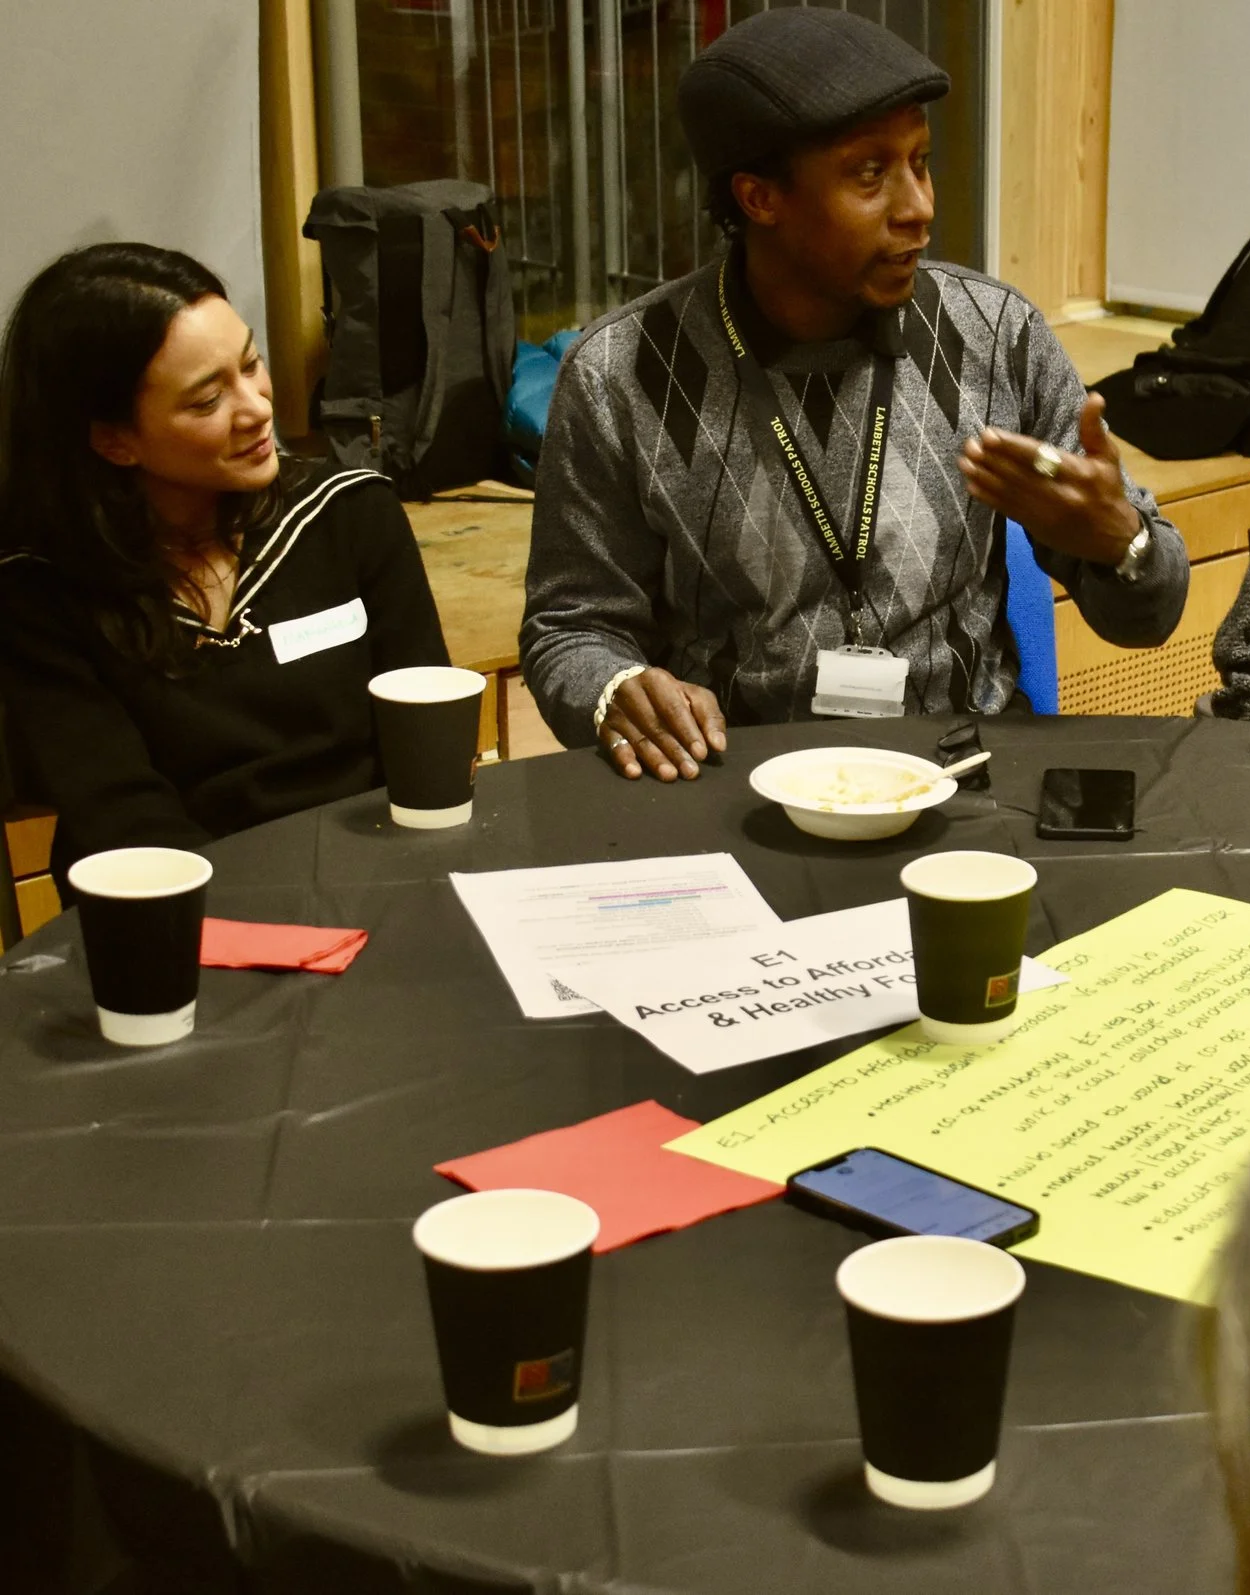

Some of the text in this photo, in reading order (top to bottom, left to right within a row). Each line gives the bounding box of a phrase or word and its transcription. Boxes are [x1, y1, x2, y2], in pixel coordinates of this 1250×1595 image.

[721, 305, 746, 359] LAMBETH
[770, 415, 845, 562] LAMBETH SCHOOLS PATROL
[856, 406, 886, 561] LAMBETH SCHOOLS PATROL
[634, 949, 914, 1020] Access to Afforda
[750, 949, 798, 968] E1
[707, 974, 918, 1028] & Healthy Fo
[716, 1130, 756, 1149] E1
[857, 1040, 938, 1077] Affordab
[1055, 953, 1089, 973] ood
[978, 1052, 1072, 1103] membership
[1014, 1107, 1055, 1133] work
[1053, 1093, 1073, 1106] at
[1051, 1119, 1100, 1149] spread
[1046, 1154, 1105, 1190] mental
[1102, 1121, 1156, 1151] health
[1091, 1168, 1142, 1198] health
